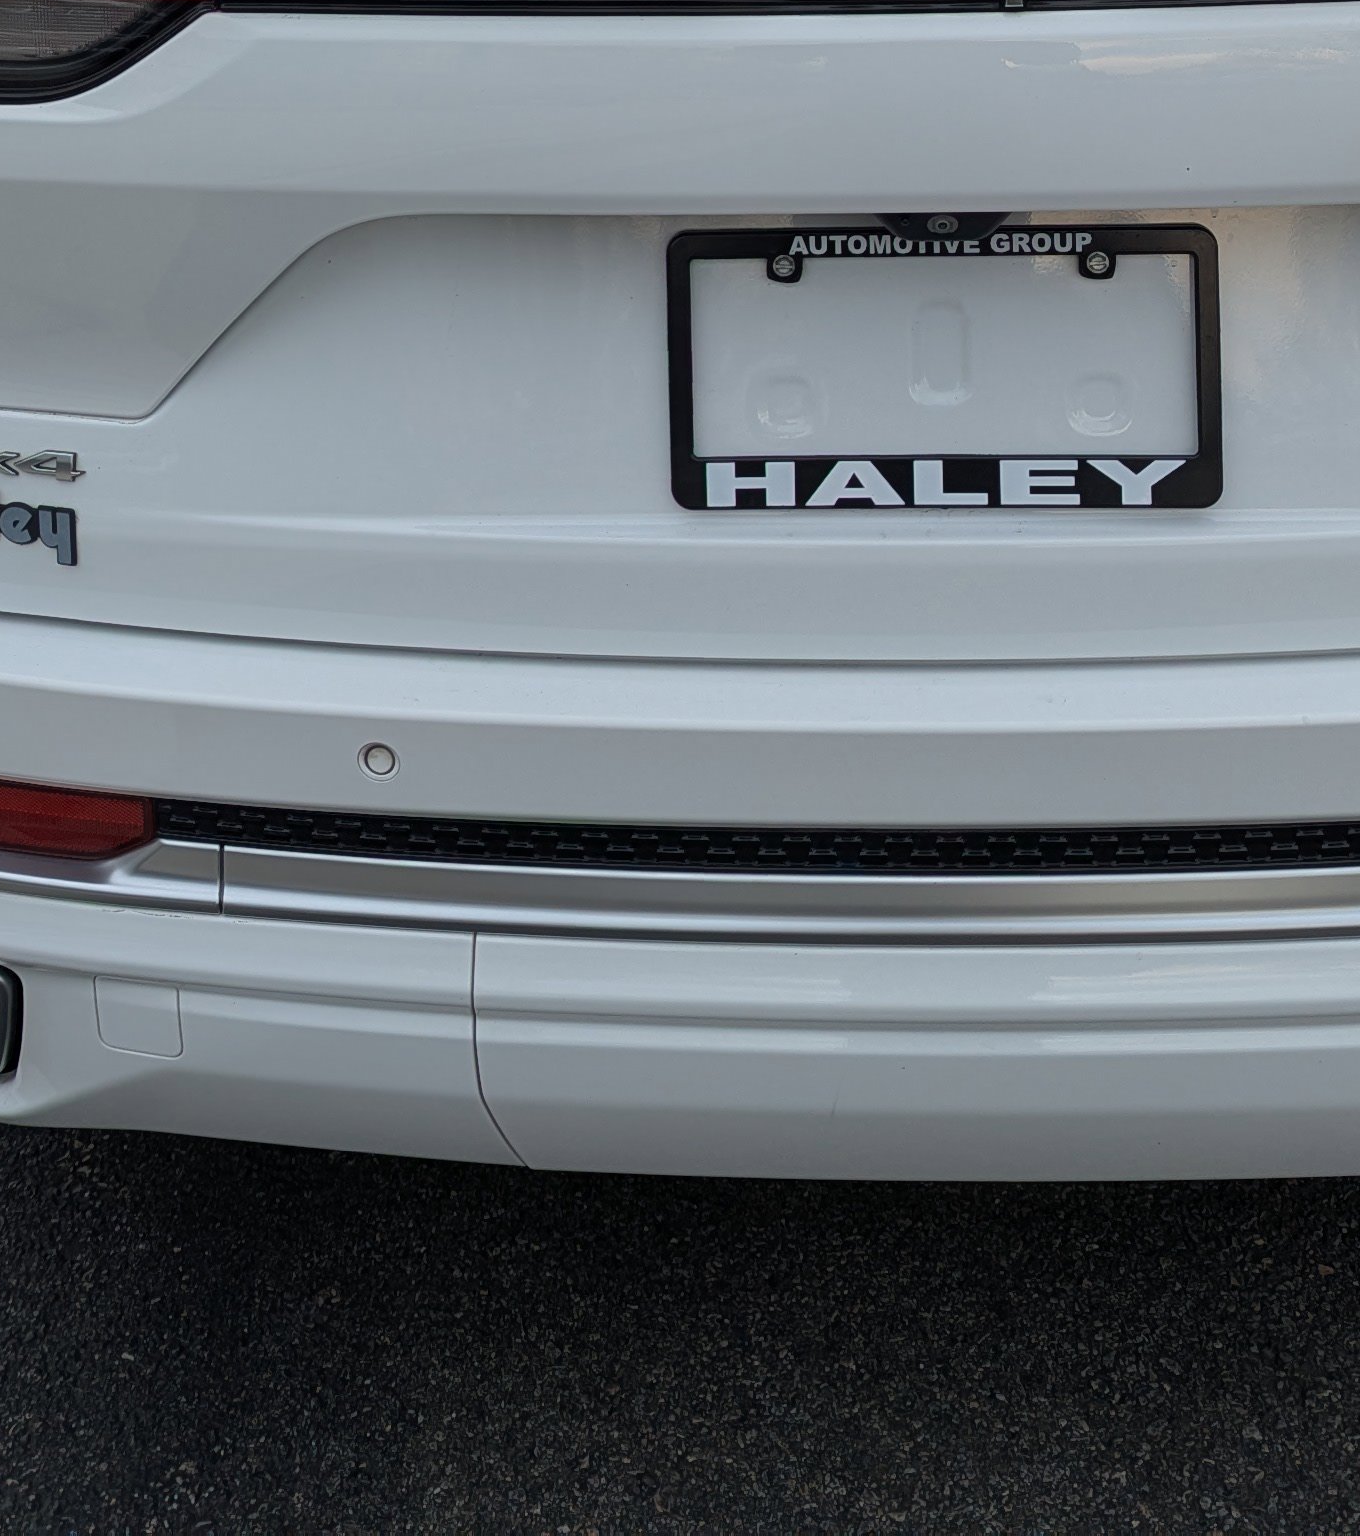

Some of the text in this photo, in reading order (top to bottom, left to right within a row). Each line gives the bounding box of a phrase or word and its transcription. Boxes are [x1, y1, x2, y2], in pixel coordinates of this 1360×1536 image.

[789, 232, 1093, 255] AUTOMOTIVE GROUP
[705, 459, 1187, 507] HALEY
